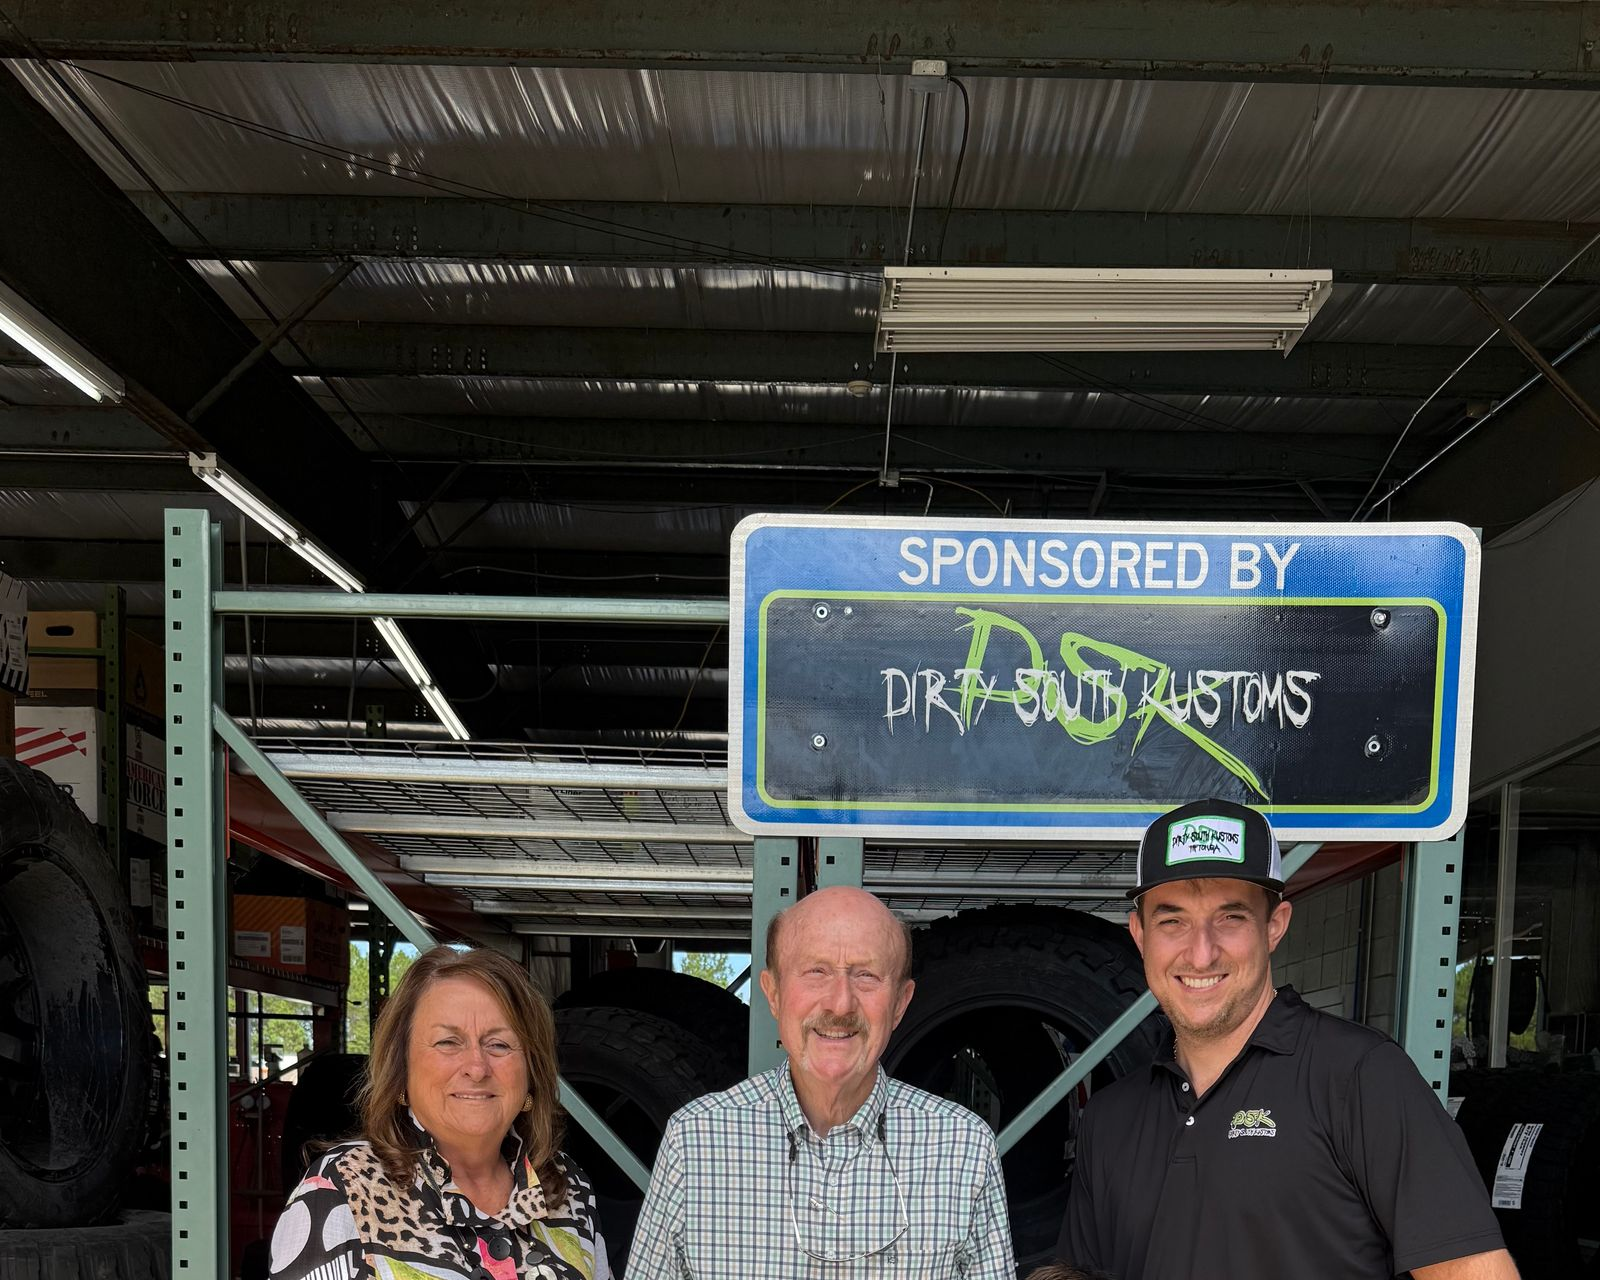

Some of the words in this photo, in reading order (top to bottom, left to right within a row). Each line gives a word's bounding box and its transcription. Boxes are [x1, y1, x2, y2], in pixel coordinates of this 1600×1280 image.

[898, 536, 1209, 590] SPONSORED
[1229, 542, 1301, 590] BY
[880, 659, 997, 737] DIRTY
[1011, 662, 1128, 728] SOUTH
[1138, 668, 1321, 730] KUSTOMS
